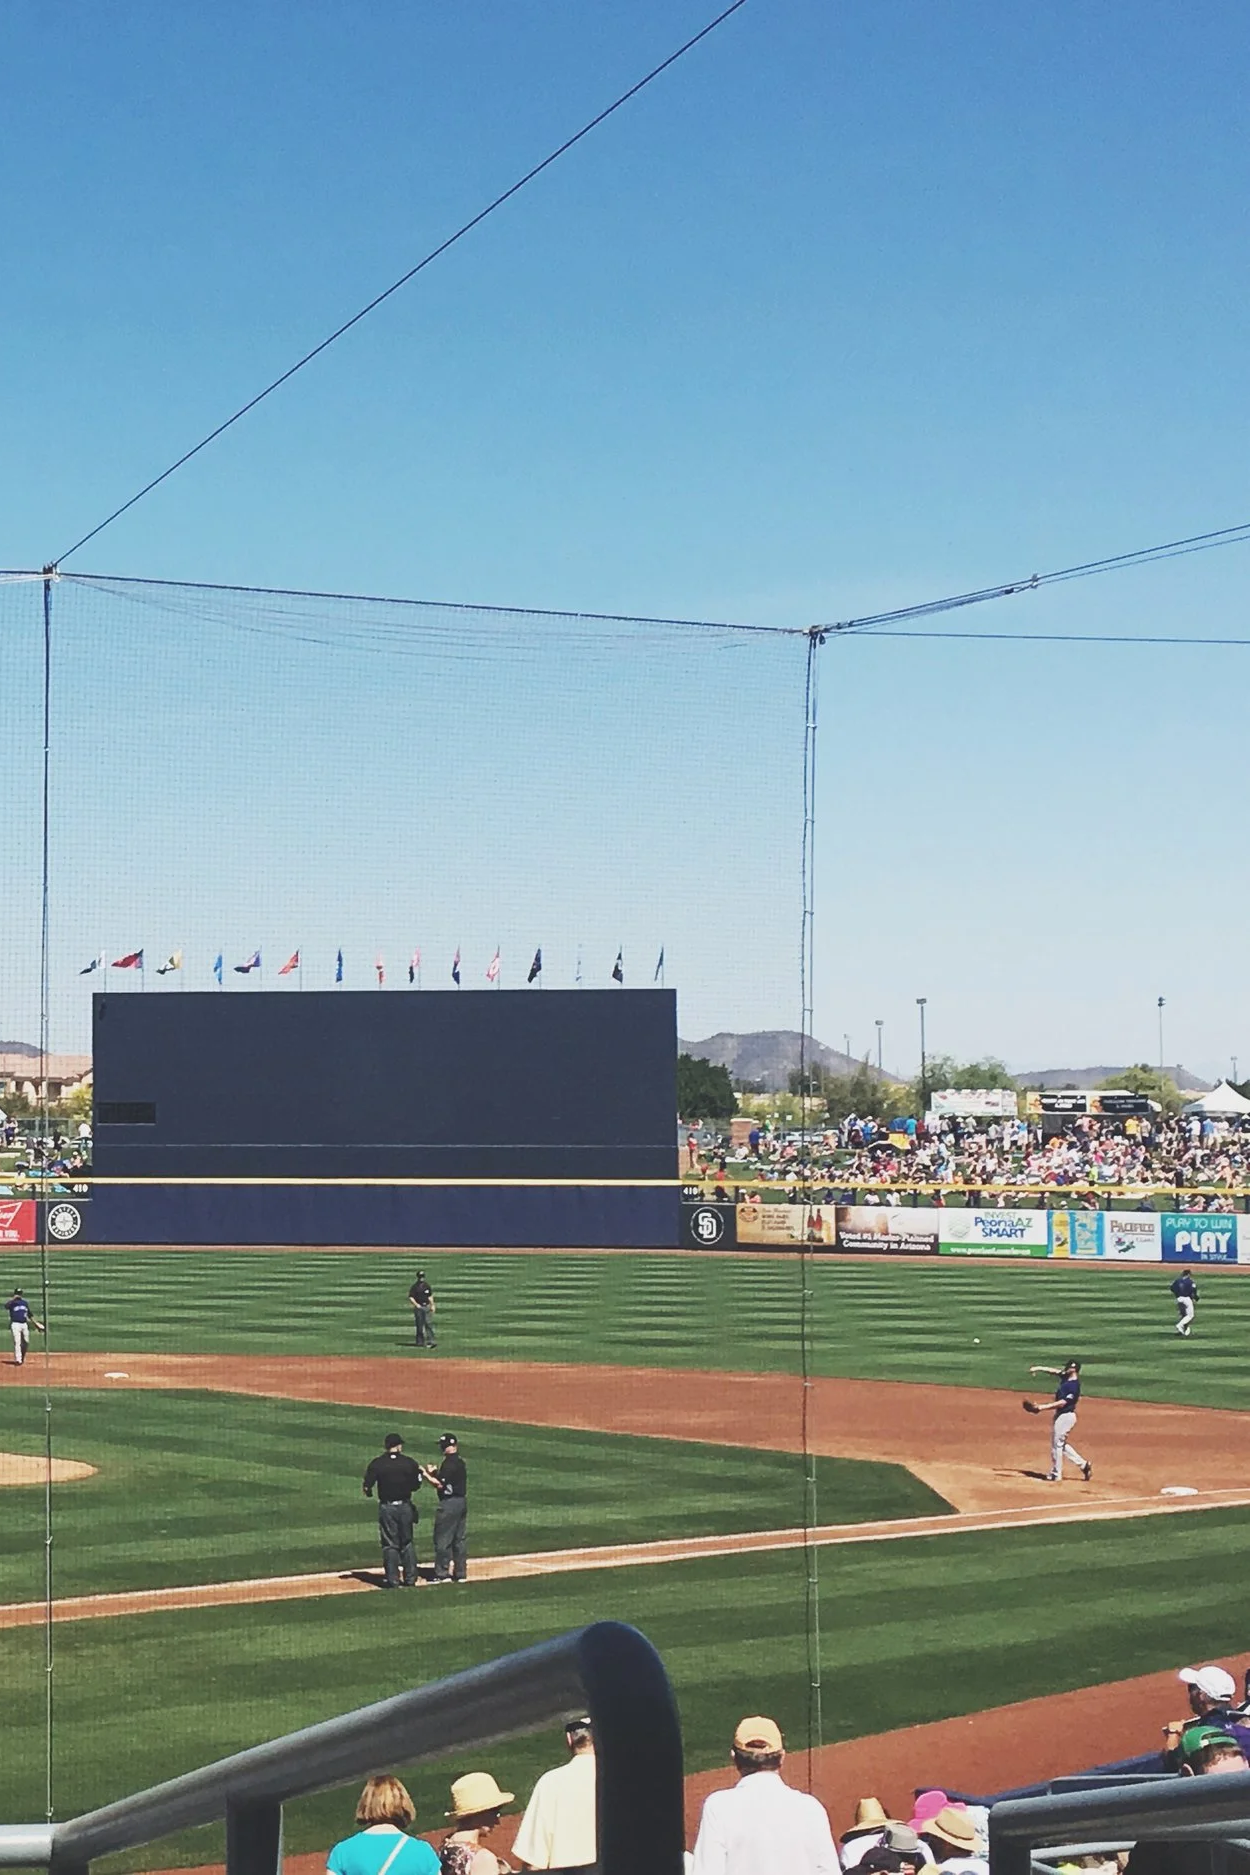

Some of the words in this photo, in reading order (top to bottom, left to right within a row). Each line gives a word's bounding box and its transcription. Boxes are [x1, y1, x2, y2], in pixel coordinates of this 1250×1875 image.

[1165, 1217, 1191, 1227] PLAY
[1194, 1217, 1208, 1228] TO
[1210, 1218, 1232, 1229] WIN
[982, 1228, 1026, 1238] SMART
[842, 1240, 888, 1250] Community
[1175, 1231, 1232, 1253] PLAY
